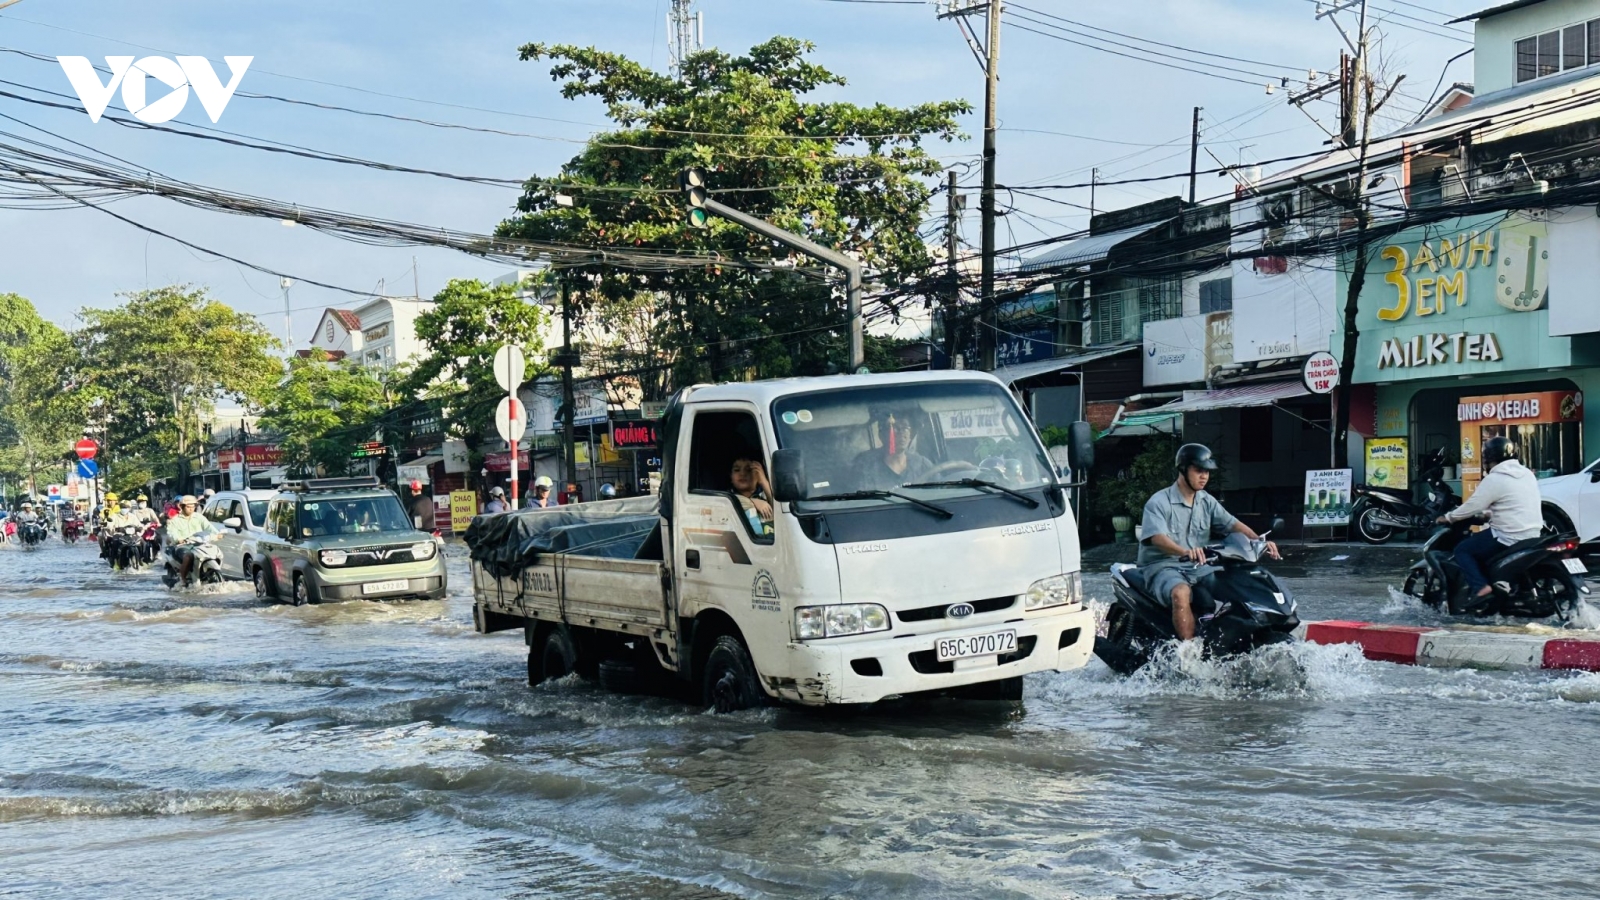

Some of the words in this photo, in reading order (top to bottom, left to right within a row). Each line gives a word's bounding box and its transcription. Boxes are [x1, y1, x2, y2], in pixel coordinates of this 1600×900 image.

[1377, 245, 1412, 321] 3
[1411, 230, 1496, 272] ANH
[1415, 270, 1469, 316] EM
[1378, 333, 1449, 370] MILK
[1449, 331, 1503, 363] TEA
[1314, 380, 1330, 390] 15K
[1457, 402, 1482, 422] LINH
[1496, 399, 1540, 421] KEBAB
[614, 422, 640, 446] QUẢNG
[1001, 523, 1053, 537] FRONTIER
[842, 543, 889, 555] THACO
[952, 604, 970, 616] KIA
